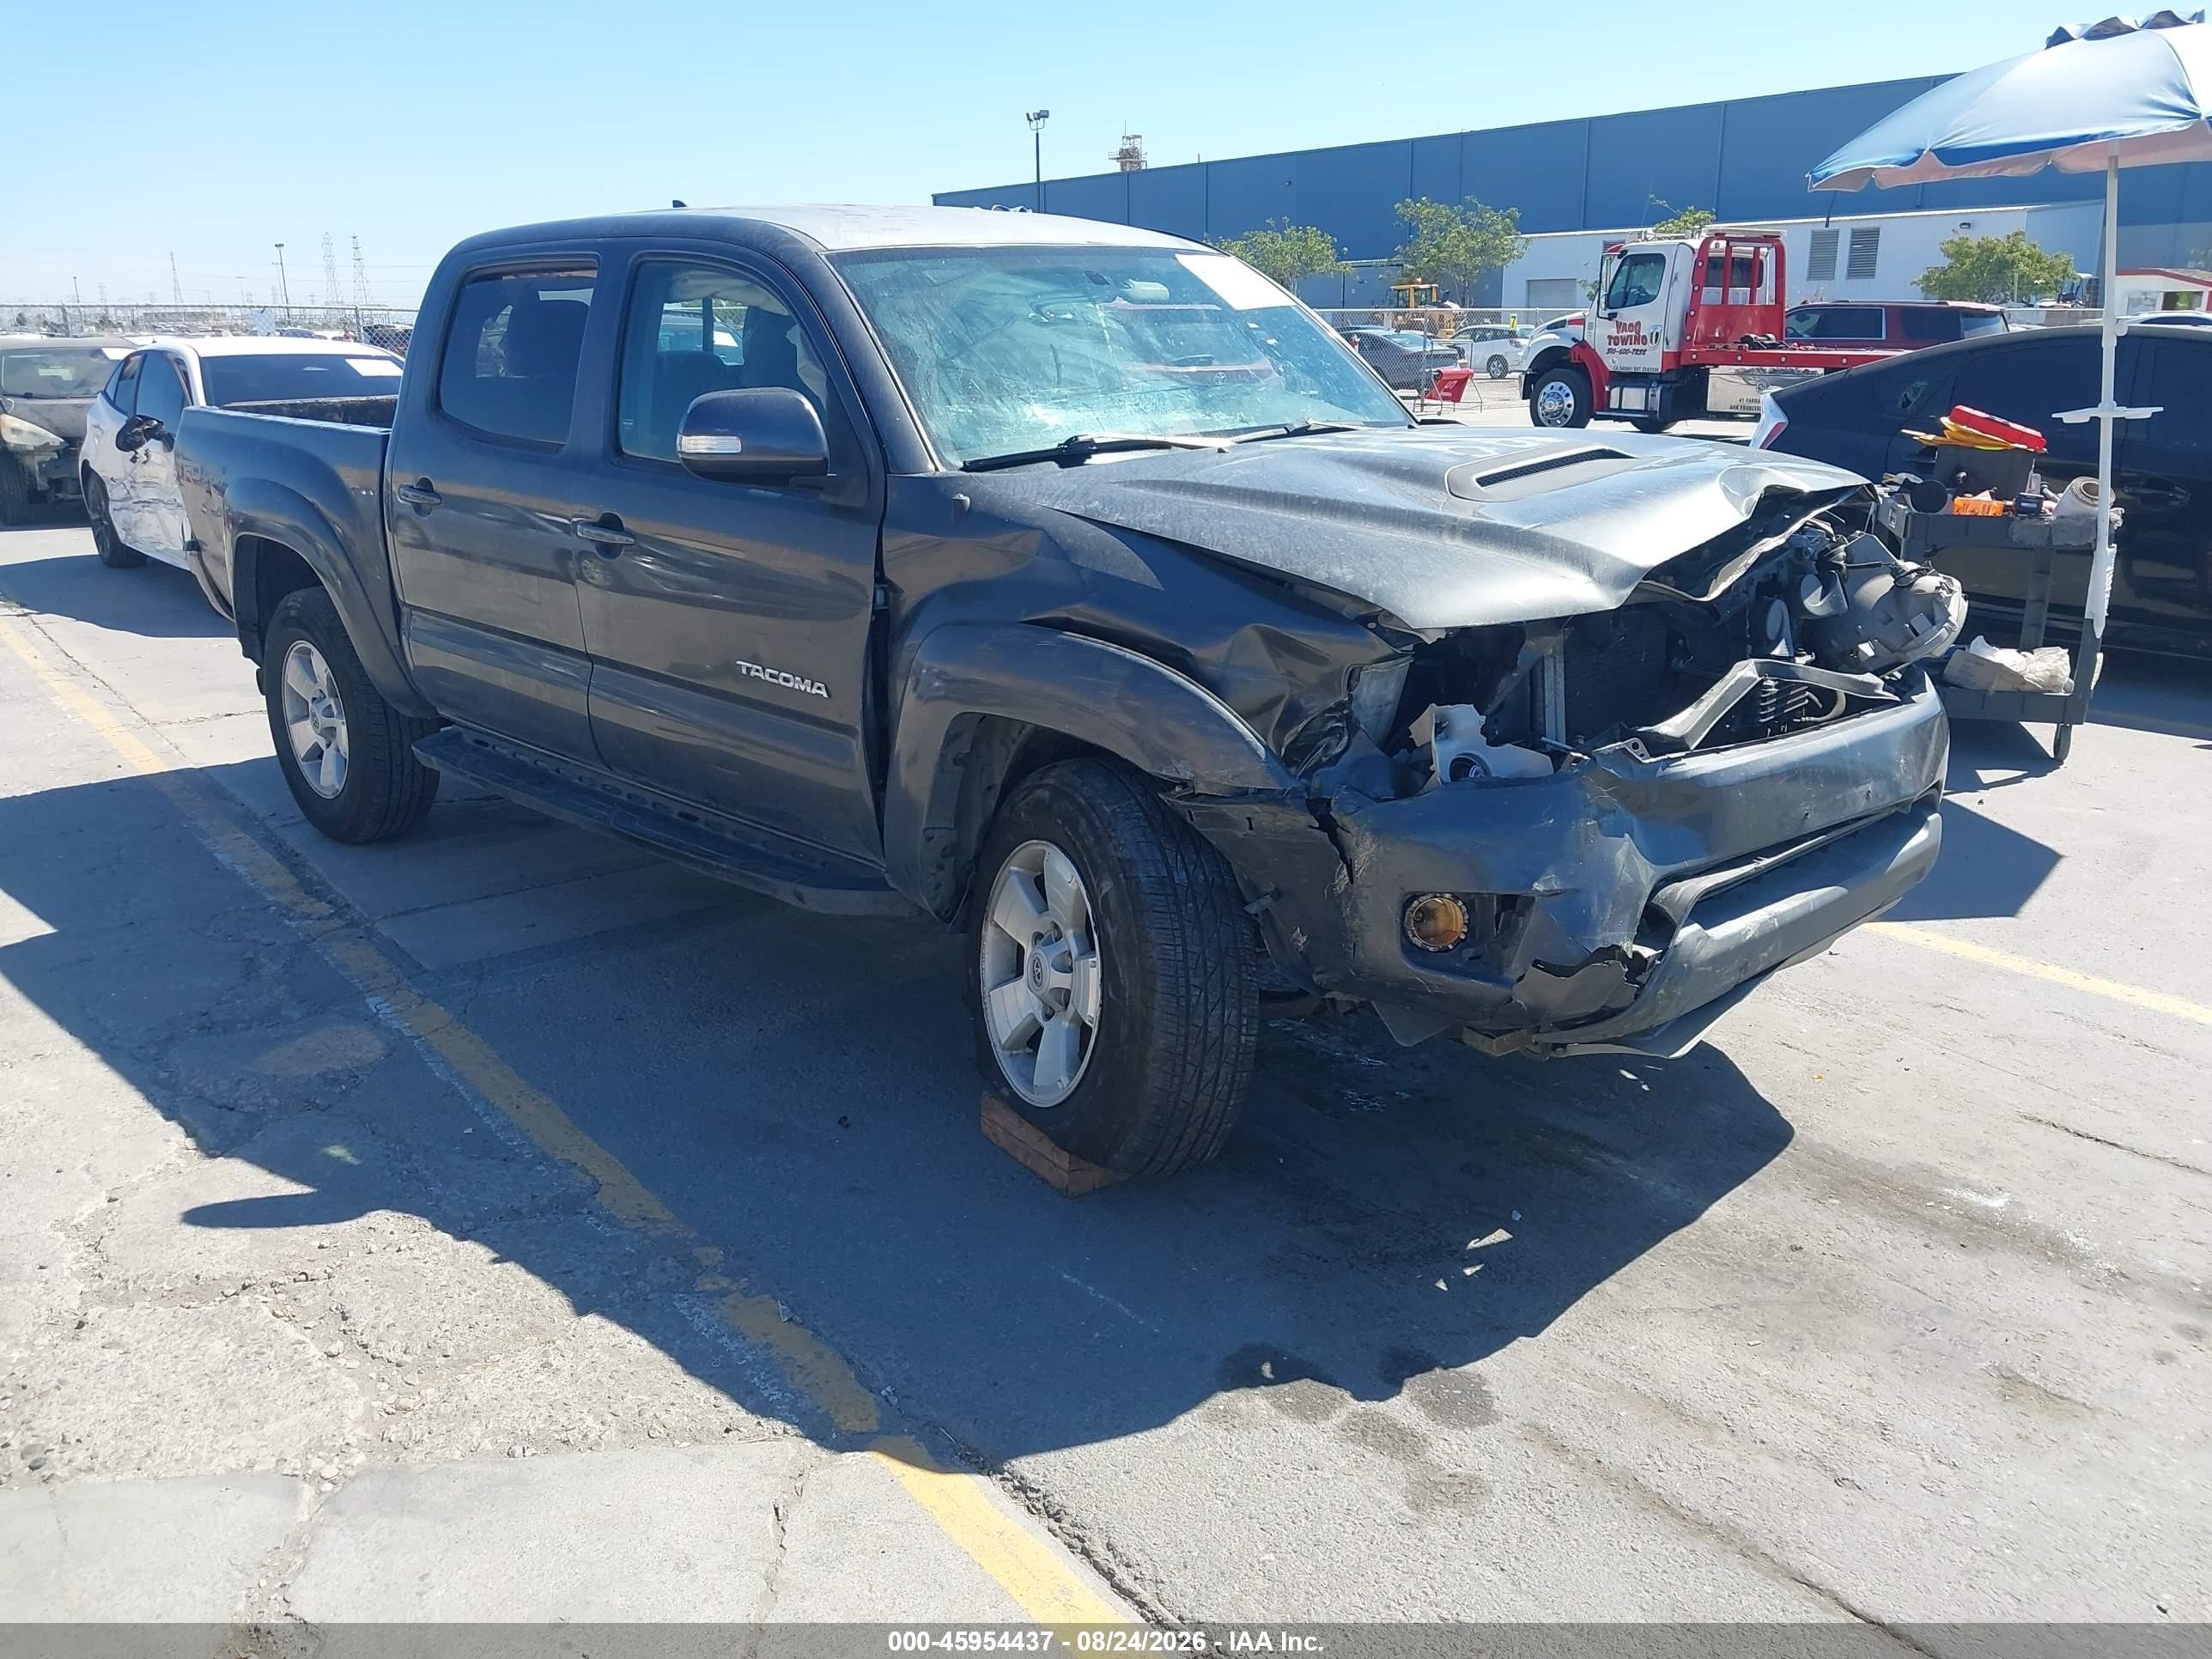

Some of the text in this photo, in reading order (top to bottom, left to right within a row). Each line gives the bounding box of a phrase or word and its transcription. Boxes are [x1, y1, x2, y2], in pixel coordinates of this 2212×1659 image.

[1510, 315, 1516, 328] 7
[1607, 334, 1648, 346] TOWING
[736, 660, 829, 698] TACOMA
